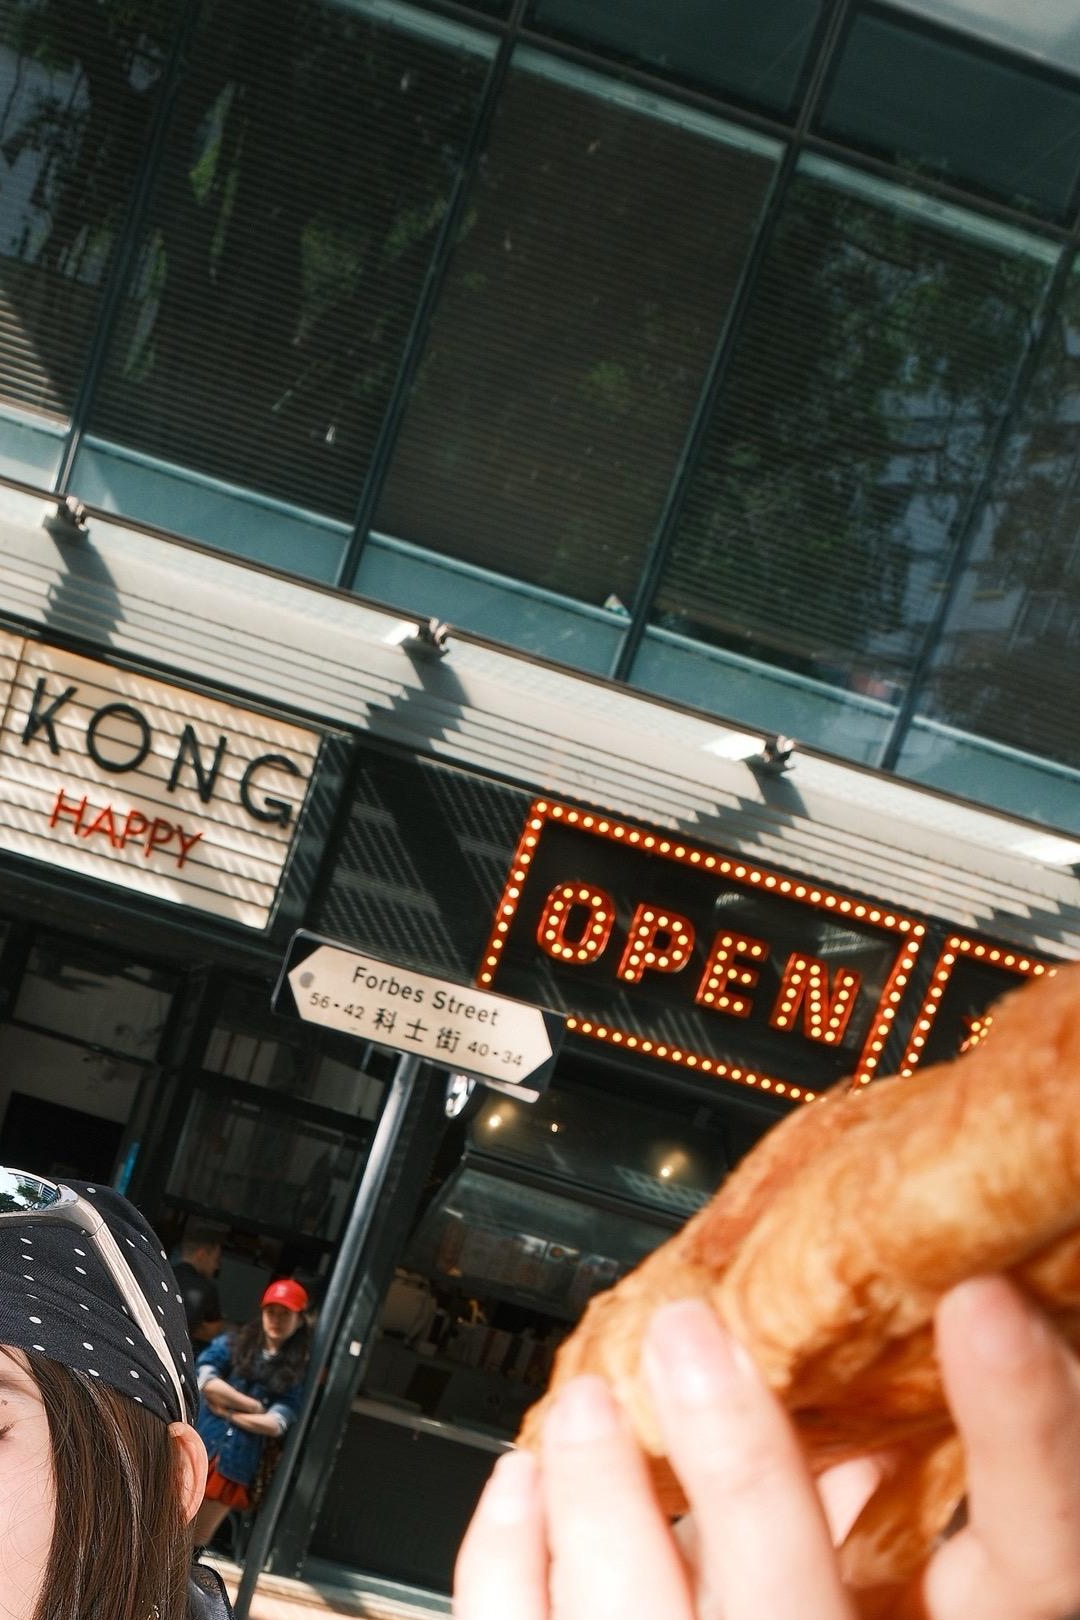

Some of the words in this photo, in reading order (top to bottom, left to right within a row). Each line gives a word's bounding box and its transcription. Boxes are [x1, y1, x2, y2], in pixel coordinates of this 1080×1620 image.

[20, 676, 302, 829] KONG
[49, 788, 204, 869] HAPPY
[352, 966, 424, 1004] Forbes
[431, 990, 501, 1027] Street
[536, 880, 862, 1047] OPEN
[373, 1006, 462, 1054] 科士街
